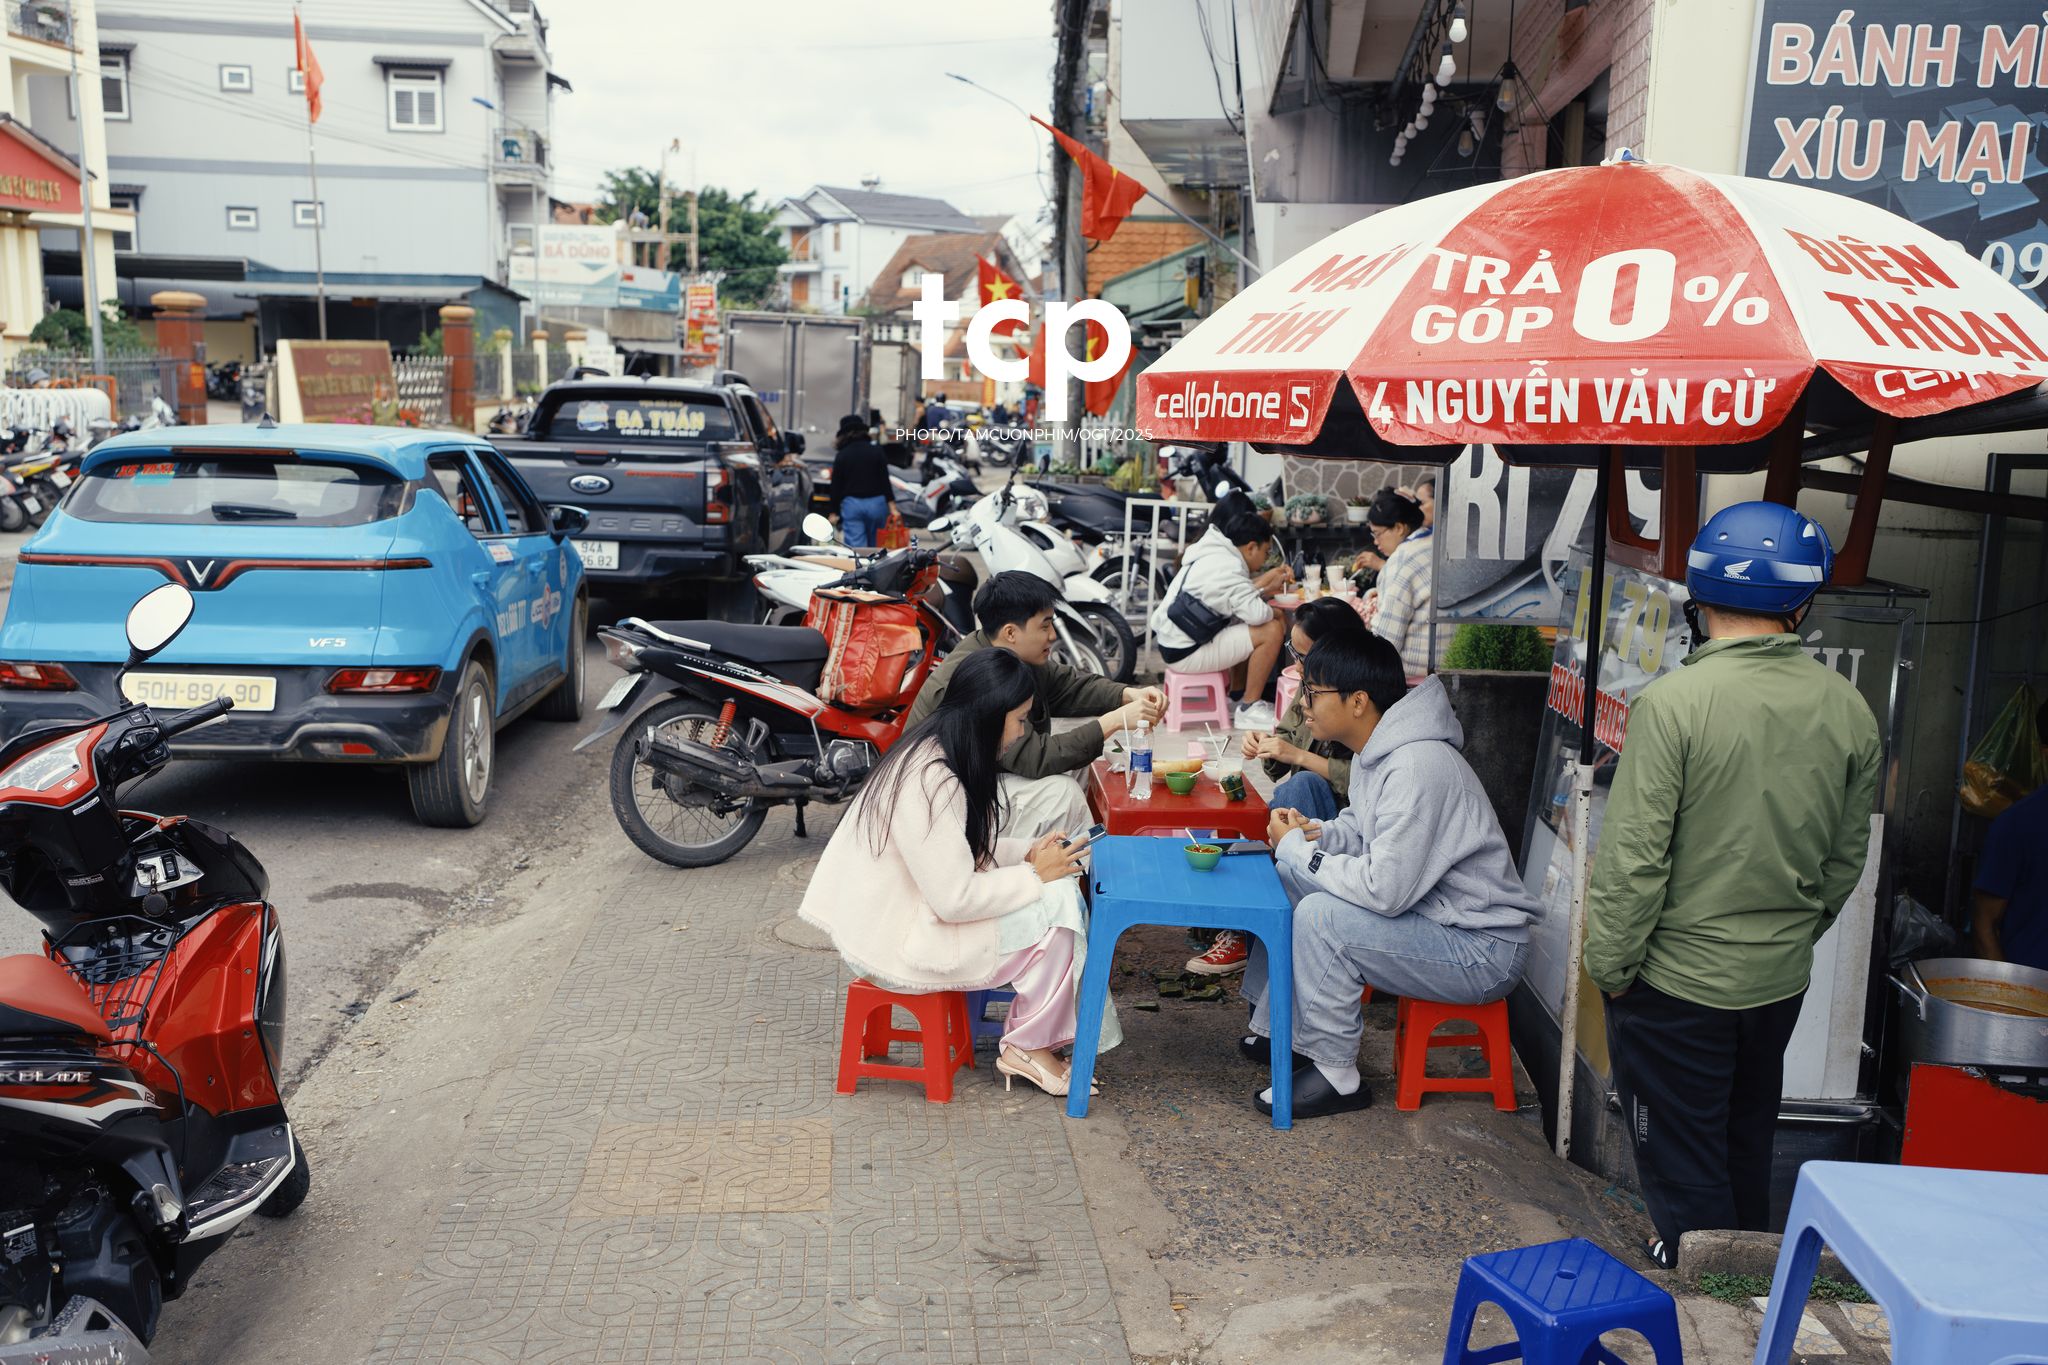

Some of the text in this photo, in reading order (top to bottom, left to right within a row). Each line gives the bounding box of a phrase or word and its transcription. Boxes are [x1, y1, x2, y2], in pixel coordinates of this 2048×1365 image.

[1767, 9, 1961, 88] BÁNH
[1768, 105, 2031, 195] XÍU MẠI
[1289, 241, 1424, 293] MÁY
[1432, 249, 1562, 296] TRẢ
[1783, 228, 1960, 296] ĐIỆN
[1216, 302, 1351, 355] TÍNH
[1410, 298, 1554, 344] GÓP
[1823, 290, 2048, 371] THOẠI
[1369, 360, 1777, 428] 4 NGUYỄN VĂN CỪ
[1724, 573, 1752, 581] HONDA
